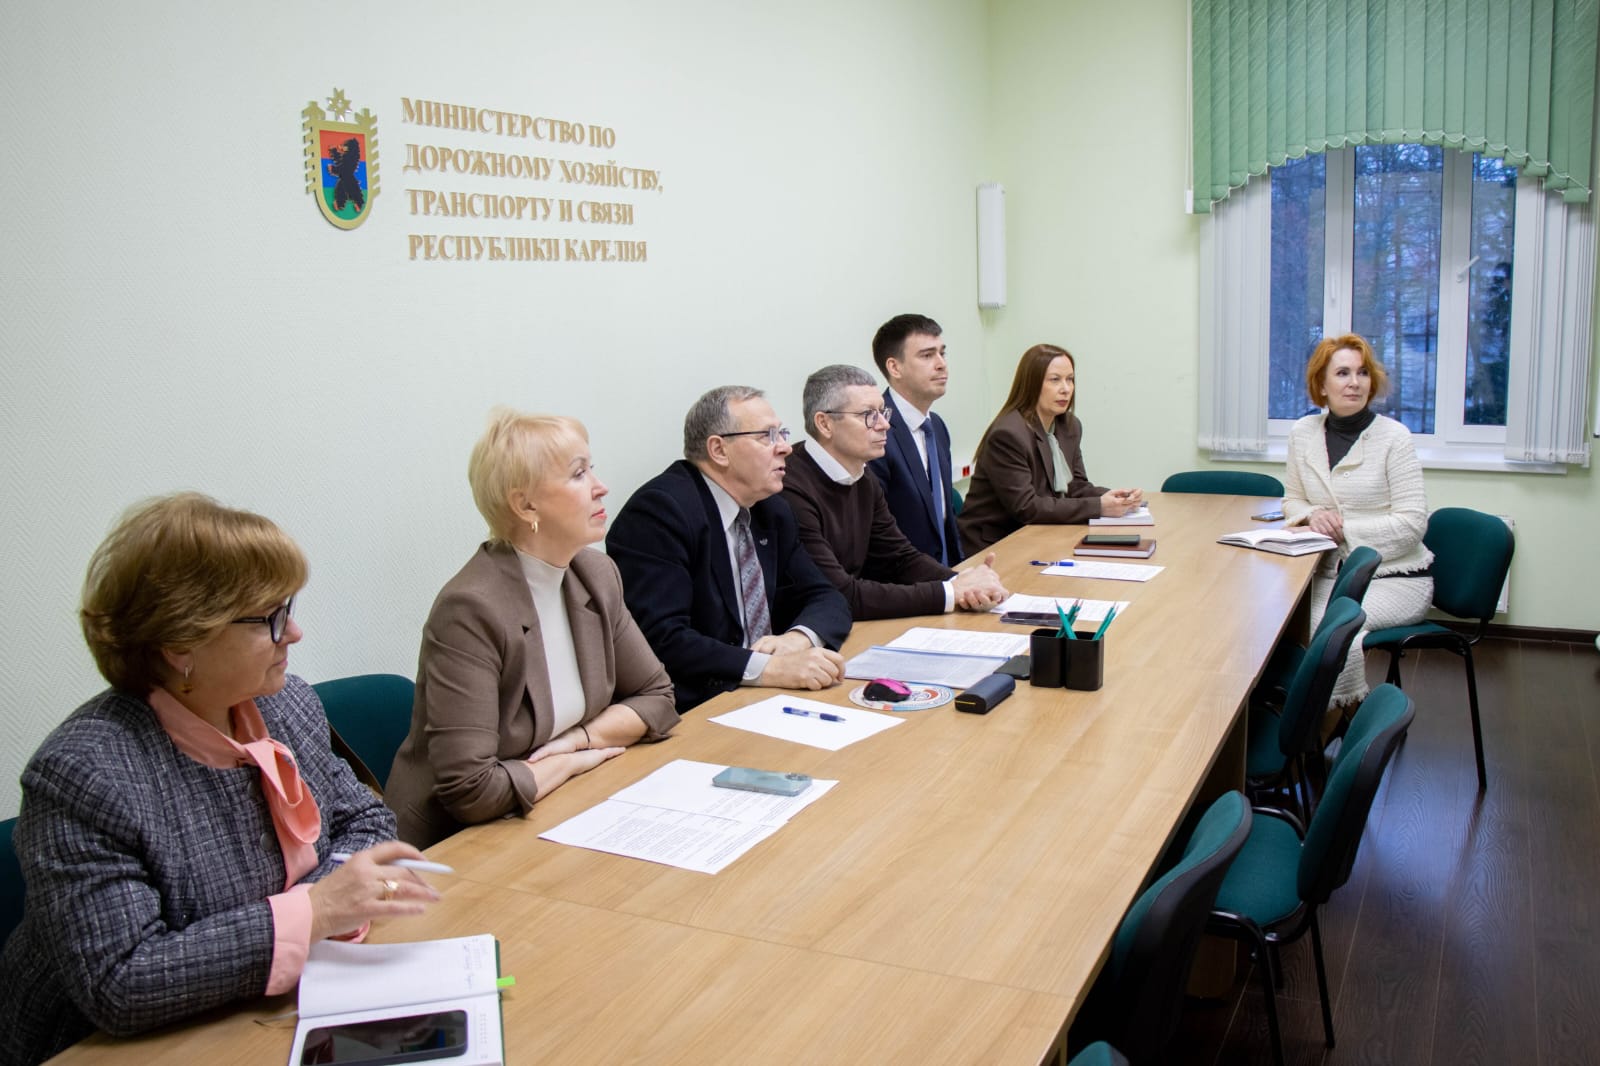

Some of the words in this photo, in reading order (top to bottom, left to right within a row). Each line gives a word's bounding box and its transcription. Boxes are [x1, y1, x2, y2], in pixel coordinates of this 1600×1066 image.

[401, 97, 585, 144] МИНИСТЕРСТВО
[588, 125, 616, 149] ПО
[402, 143, 554, 181] ДОРОЖНОМУ
[559, 159, 663, 193] ХОЗЯЙСТВУ,
[405, 188, 554, 220] ТРАНСПОРТУ
[558, 199, 573, 222] И
[577, 200, 634, 225] СВЯЗИ
[408, 234, 560, 262] РЕСПУБЛИКИ
[564, 238, 648, 262] КАРЕЛИЯ
